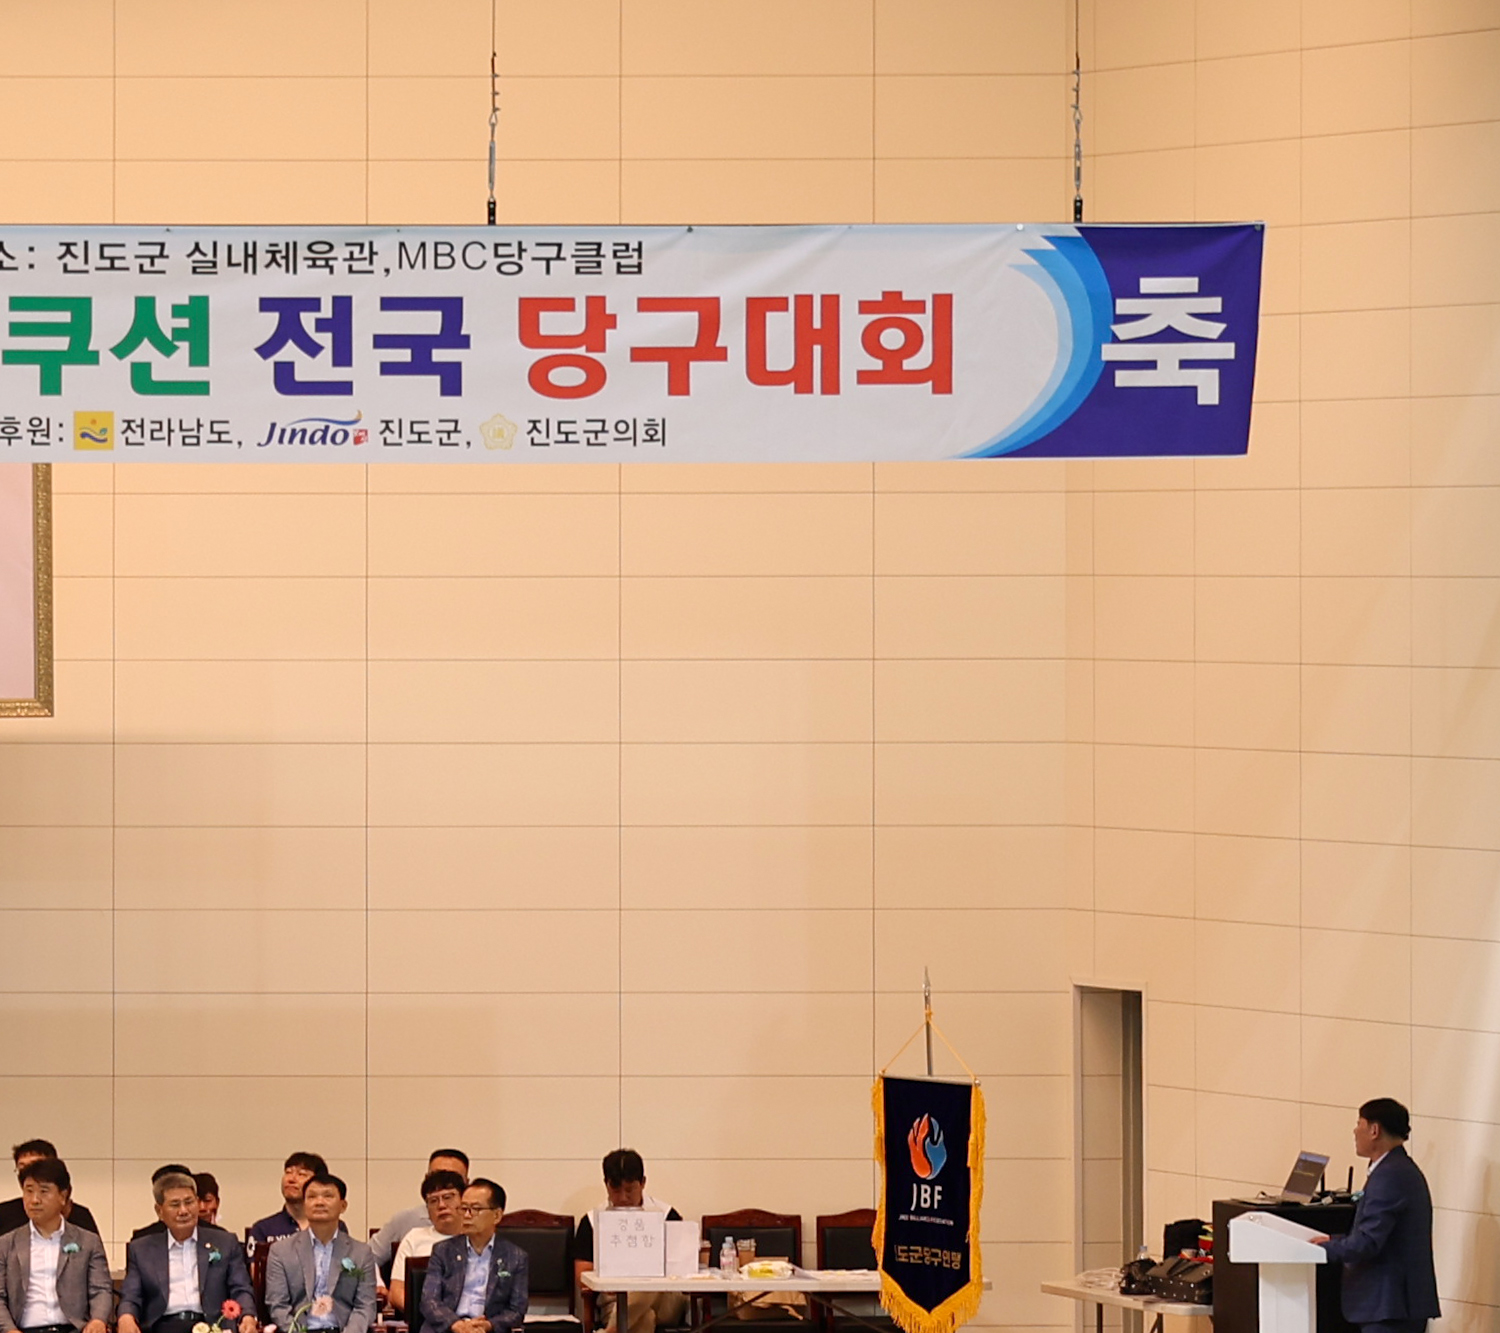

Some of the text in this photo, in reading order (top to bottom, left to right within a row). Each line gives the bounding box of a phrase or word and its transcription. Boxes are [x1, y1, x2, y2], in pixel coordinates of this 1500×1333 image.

[56, 238, 170, 276] 진도군
[252, 294, 473, 398] 전국
[515, 290, 955, 398] 당구대회
[1099, 276, 1236, 405] 축
[120, 416, 243, 450] 전라남도,
[378, 417, 471, 449] 진도군,
[525, 416, 668, 448] 진도군의회
[910, 1183, 943, 1211] JBF
